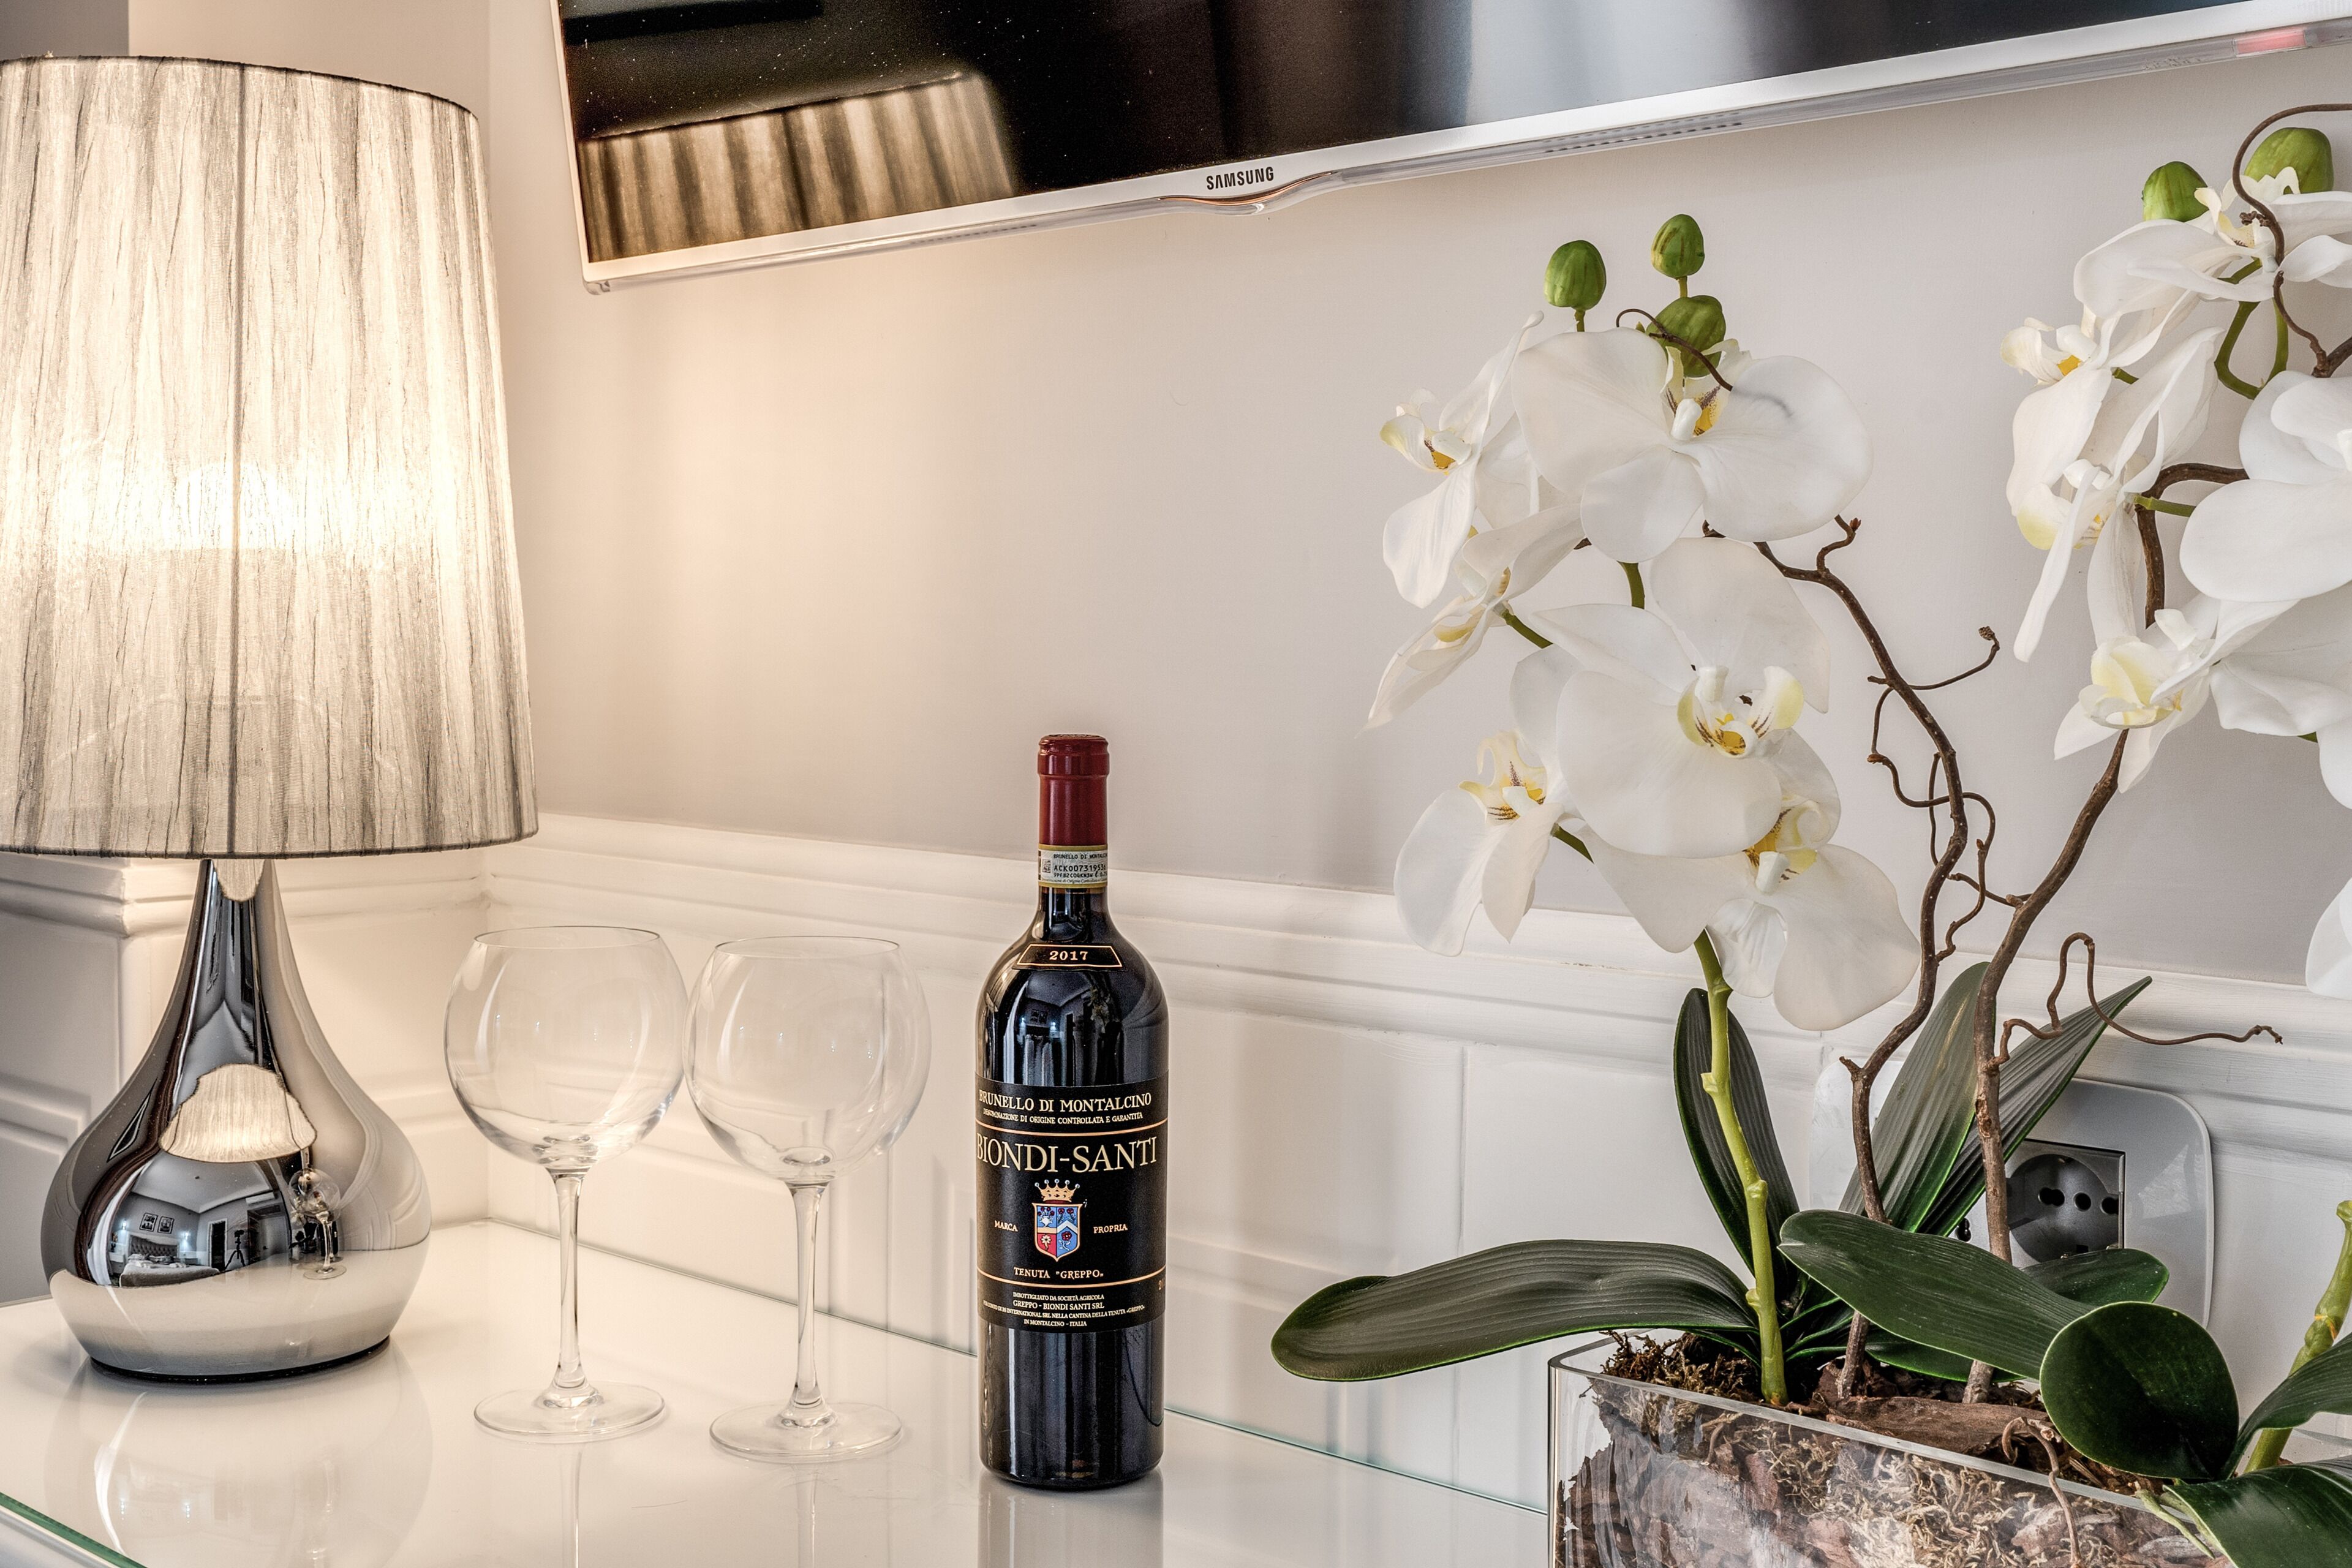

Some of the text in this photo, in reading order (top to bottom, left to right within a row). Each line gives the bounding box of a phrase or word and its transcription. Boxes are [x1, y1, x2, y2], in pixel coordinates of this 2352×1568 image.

[1206, 167, 1273, 190] SAMSUNG
[1049, 951, 1088, 960] 2017
[979, 1090, 1152, 1112] BRUNELLO DI MONTALCINO
[1112, 1112, 1143, 1122] GARANTITA
[976, 1133, 1157, 1173] BIONDI-SANTI
[994, 1220, 1018, 1232] MARCA
[1093, 1224, 1128, 1234] PROPRIA
[1014, 1267, 1050, 1279] TENUTA
[1012, 1300, 1038, 1309] GREPPO
[1007, 1308, 1041, 1317] INTERNATIONAL
